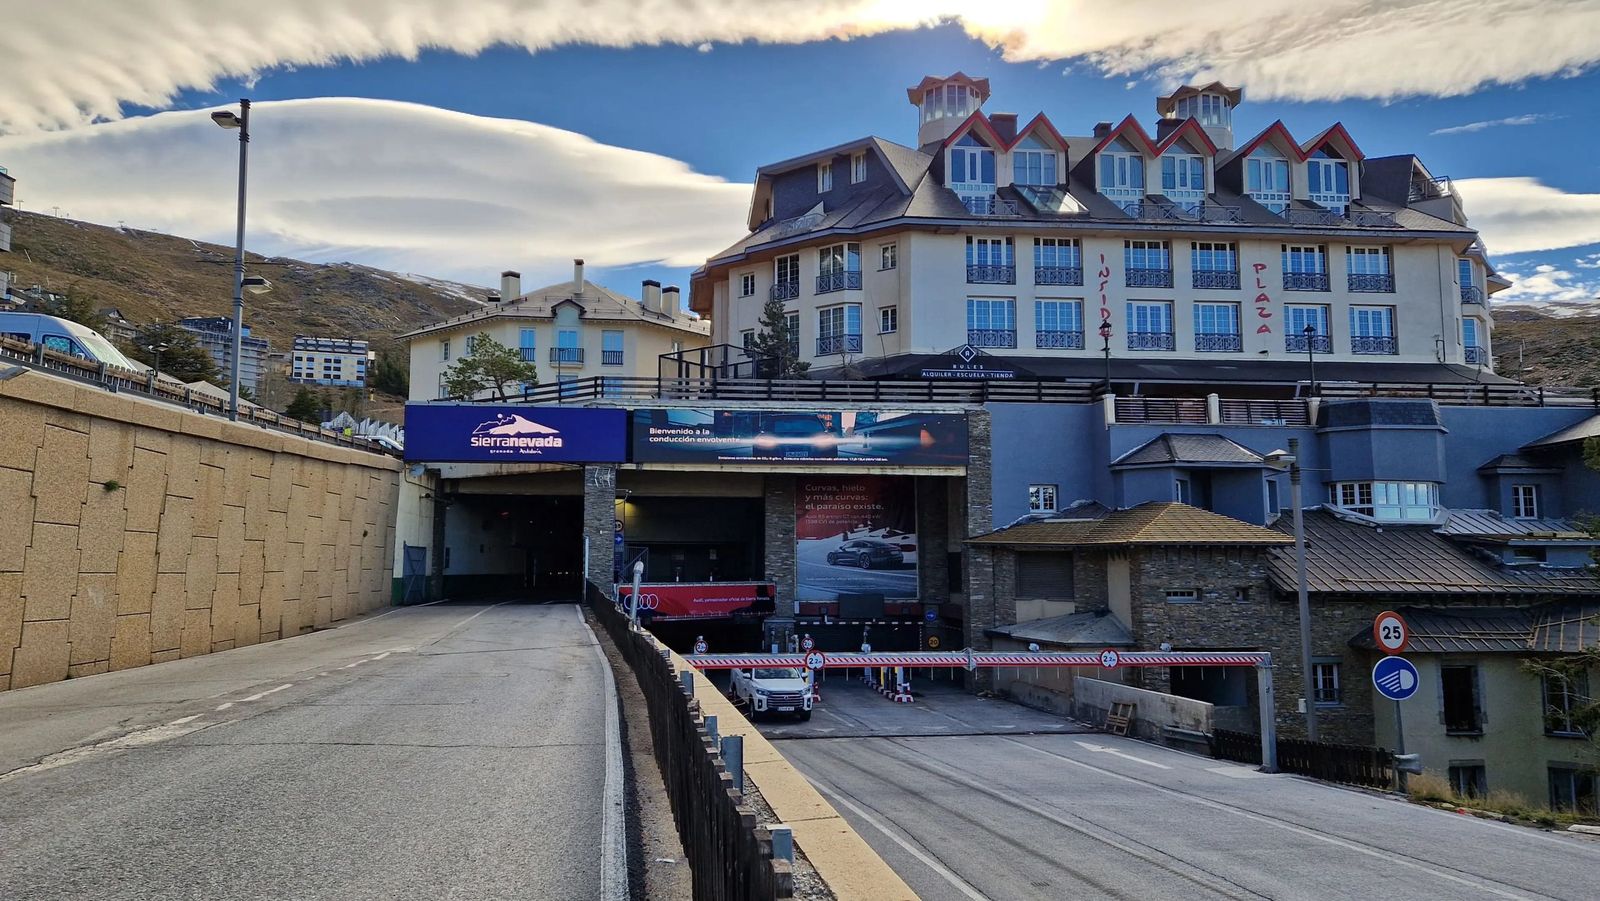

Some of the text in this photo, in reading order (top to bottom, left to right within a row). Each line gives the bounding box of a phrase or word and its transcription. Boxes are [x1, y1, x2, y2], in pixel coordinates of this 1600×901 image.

[1253, 263, 1272, 334] PLAZA
[650, 427, 694, 435] Bienvenido
[470, 434, 563, 448] sierranevada
[842, 484, 866, 492] hielo
[805, 494, 811, 502] y
[813, 493, 834, 501] más
[817, 502, 852, 511] paraíso
[853, 502, 885, 510] existe.
[1383, 626, 1401, 640] 25
